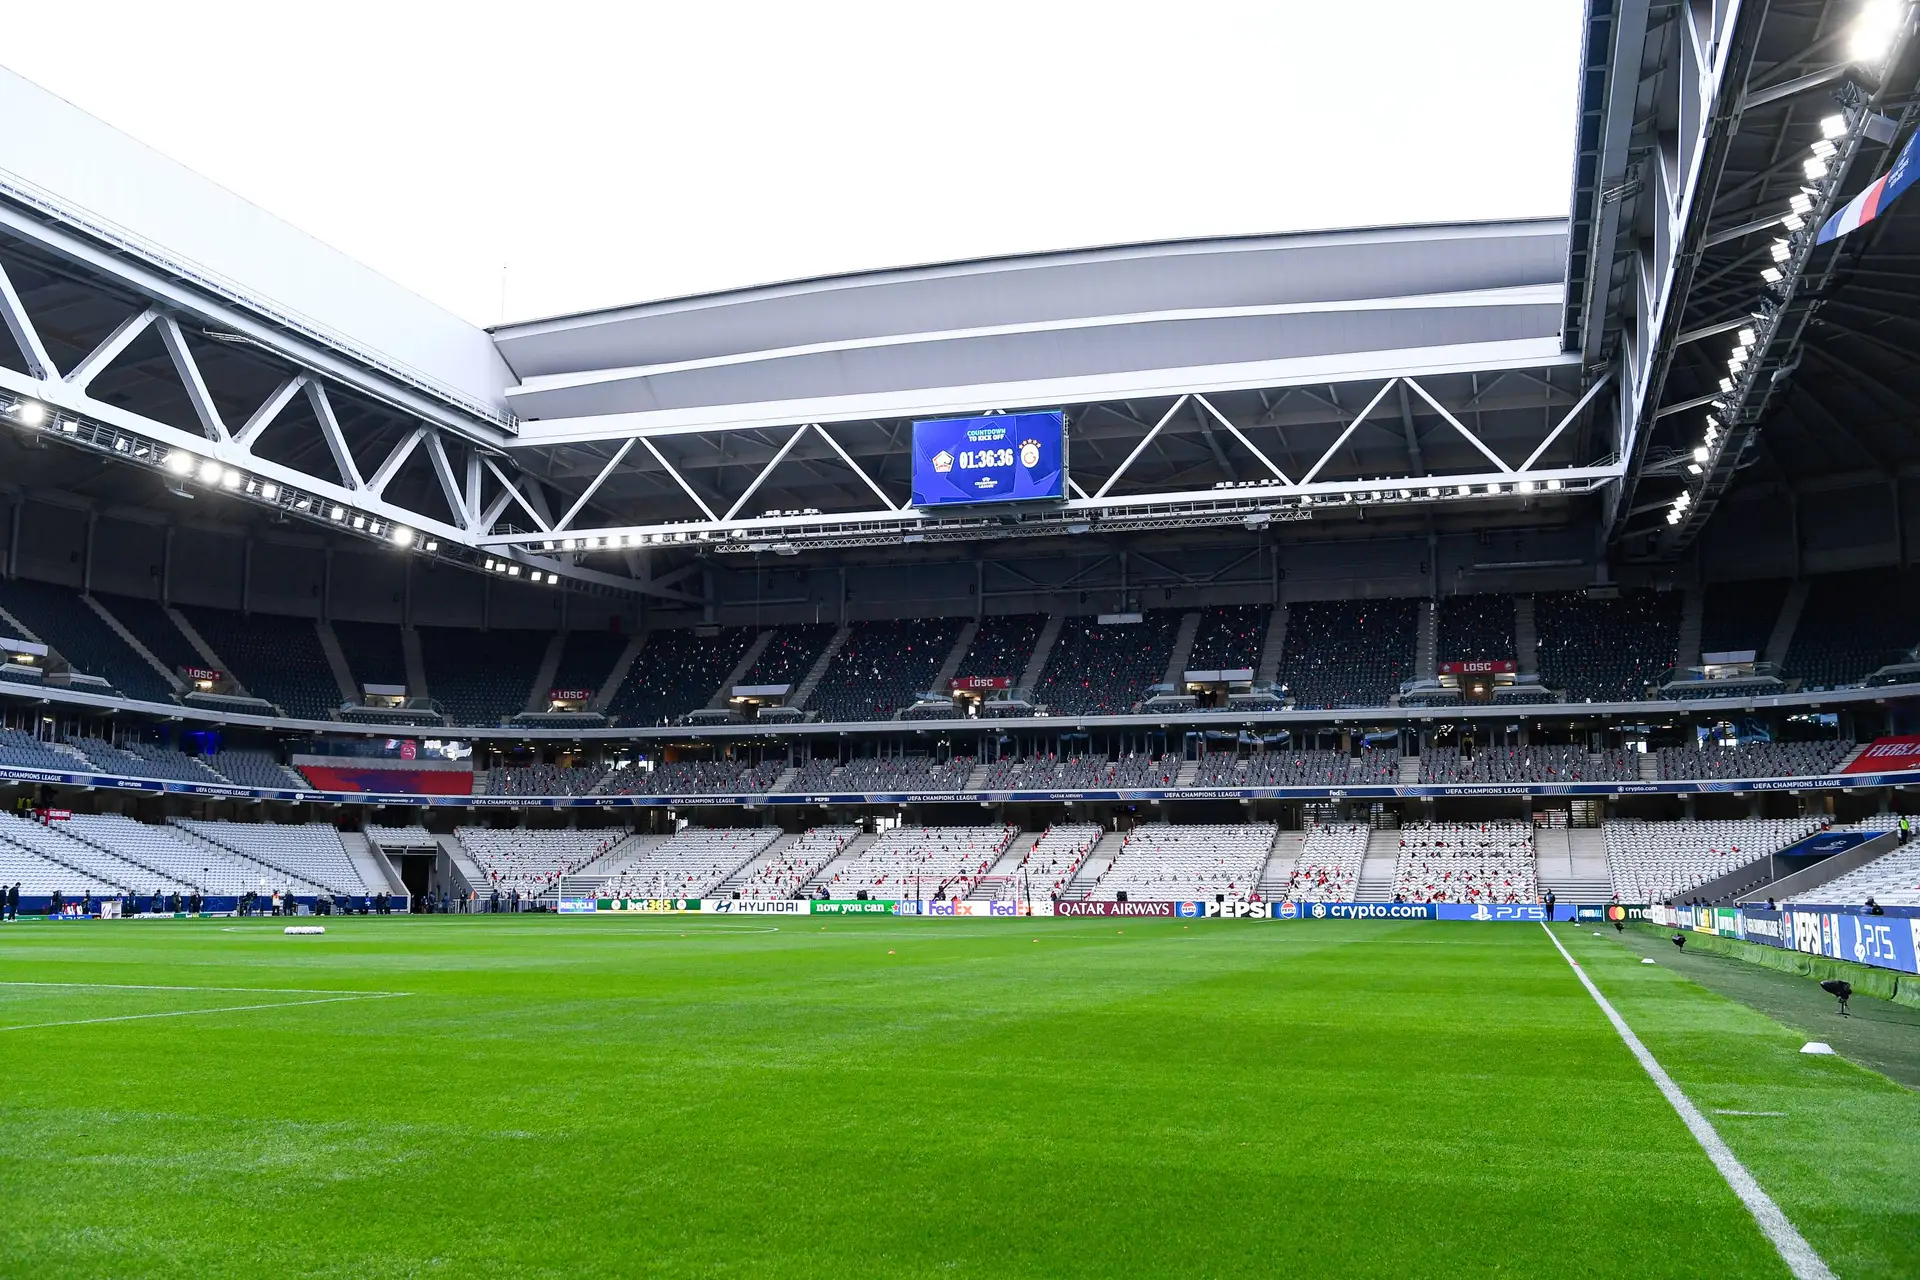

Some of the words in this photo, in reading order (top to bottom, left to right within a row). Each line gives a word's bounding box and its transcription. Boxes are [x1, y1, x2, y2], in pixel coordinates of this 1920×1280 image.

[967, 428, 1006, 436] COUNTDOWN
[959, 448, 1014, 469] 01:36:36
[1463, 662, 1492, 672] LOSC
[969, 679, 994, 687] LOSC
[558, 691, 583, 699] LOSC
[8, 771, 41, 780] CHAMPIONS
[41, 773, 62, 782] LEAGUE
[1445, 787, 1463, 795] UEFA
[1463, 786, 1503, 795] CHAMPIONS
[1503, 786, 1530, 794] LEAGUE
[1625, 785, 1658, 793] crypto.com
[1752, 782, 1772, 790] UEFA
[1772, 781, 1813, 789] CHAMPIONS
[1814, 779, 1841, 788] LEAGUE
[196, 787, 208, 795] UEFA
[207, 788, 232, 796] CHAMPIONS
[232, 789, 250, 797] LEAGUE
[1180, 791, 1217, 799] CHAMPIONS
[560, 901, 594, 910] RECYCLE
[627, 899, 672, 911] bet365
[738, 901, 799, 913] HYUNDAI
[816, 903, 839, 912] now
[840, 903, 864, 915] you
[865, 903, 886, 912] can
[929, 900, 973, 916] FedEx
[990, 900, 1035, 916] FedEx
[1058, 902, 1105, 917] QATAR
[1110, 902, 1170, 915] AIRWAYS
[1205, 901, 1272, 918] PEPSI
[1330, 904, 1428, 919] crypto.com
[1496, 906, 1545, 919] PS5
[1793, 911, 1823, 954] PEPSI
[1864, 924, 1896, 961] PS5
